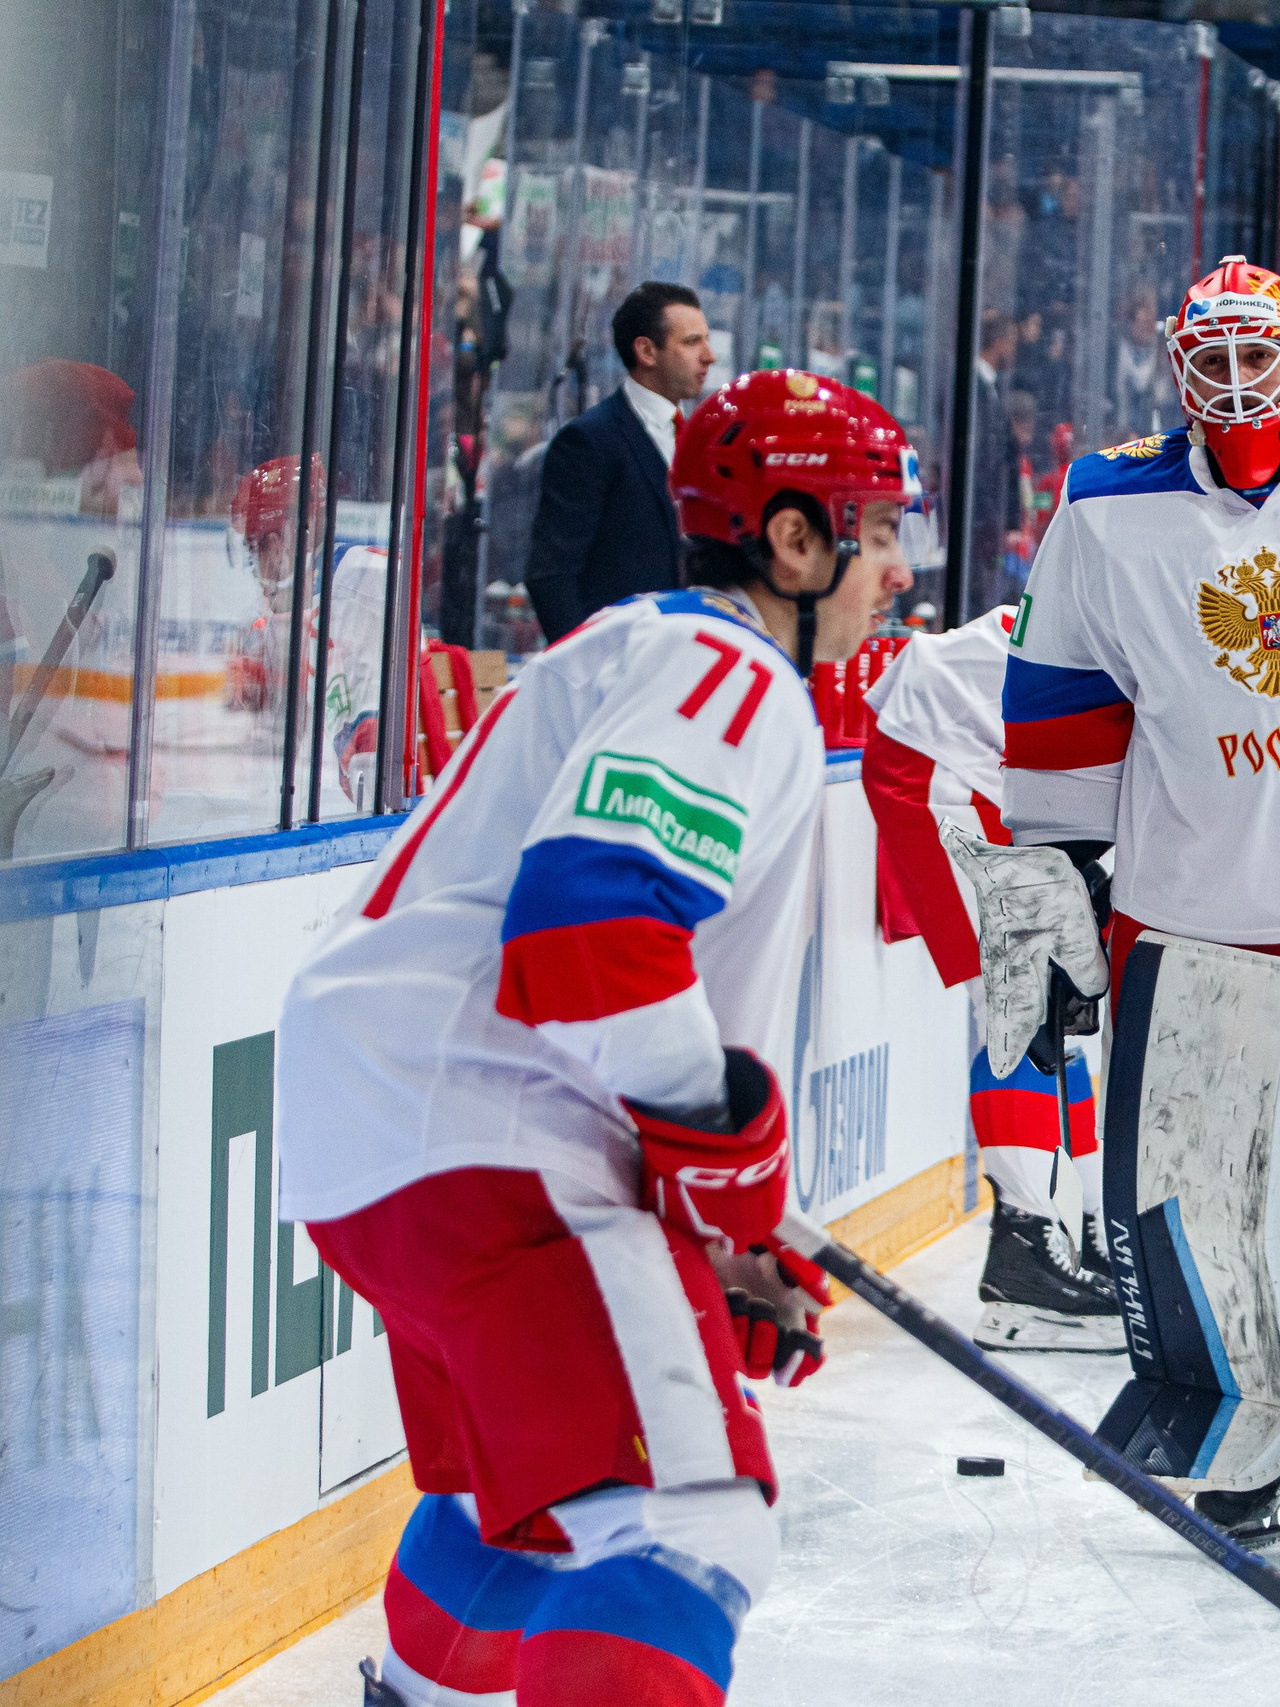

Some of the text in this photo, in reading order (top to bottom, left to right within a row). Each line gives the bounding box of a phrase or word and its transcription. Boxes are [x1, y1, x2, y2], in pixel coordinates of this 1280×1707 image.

[1215, 298, 1275, 312] НОРНИКЕЛЬ
[765, 453, 829, 466] CCM
[676, 629, 773, 747] 71
[1157, 1503, 1229, 1560] TRIGGER
